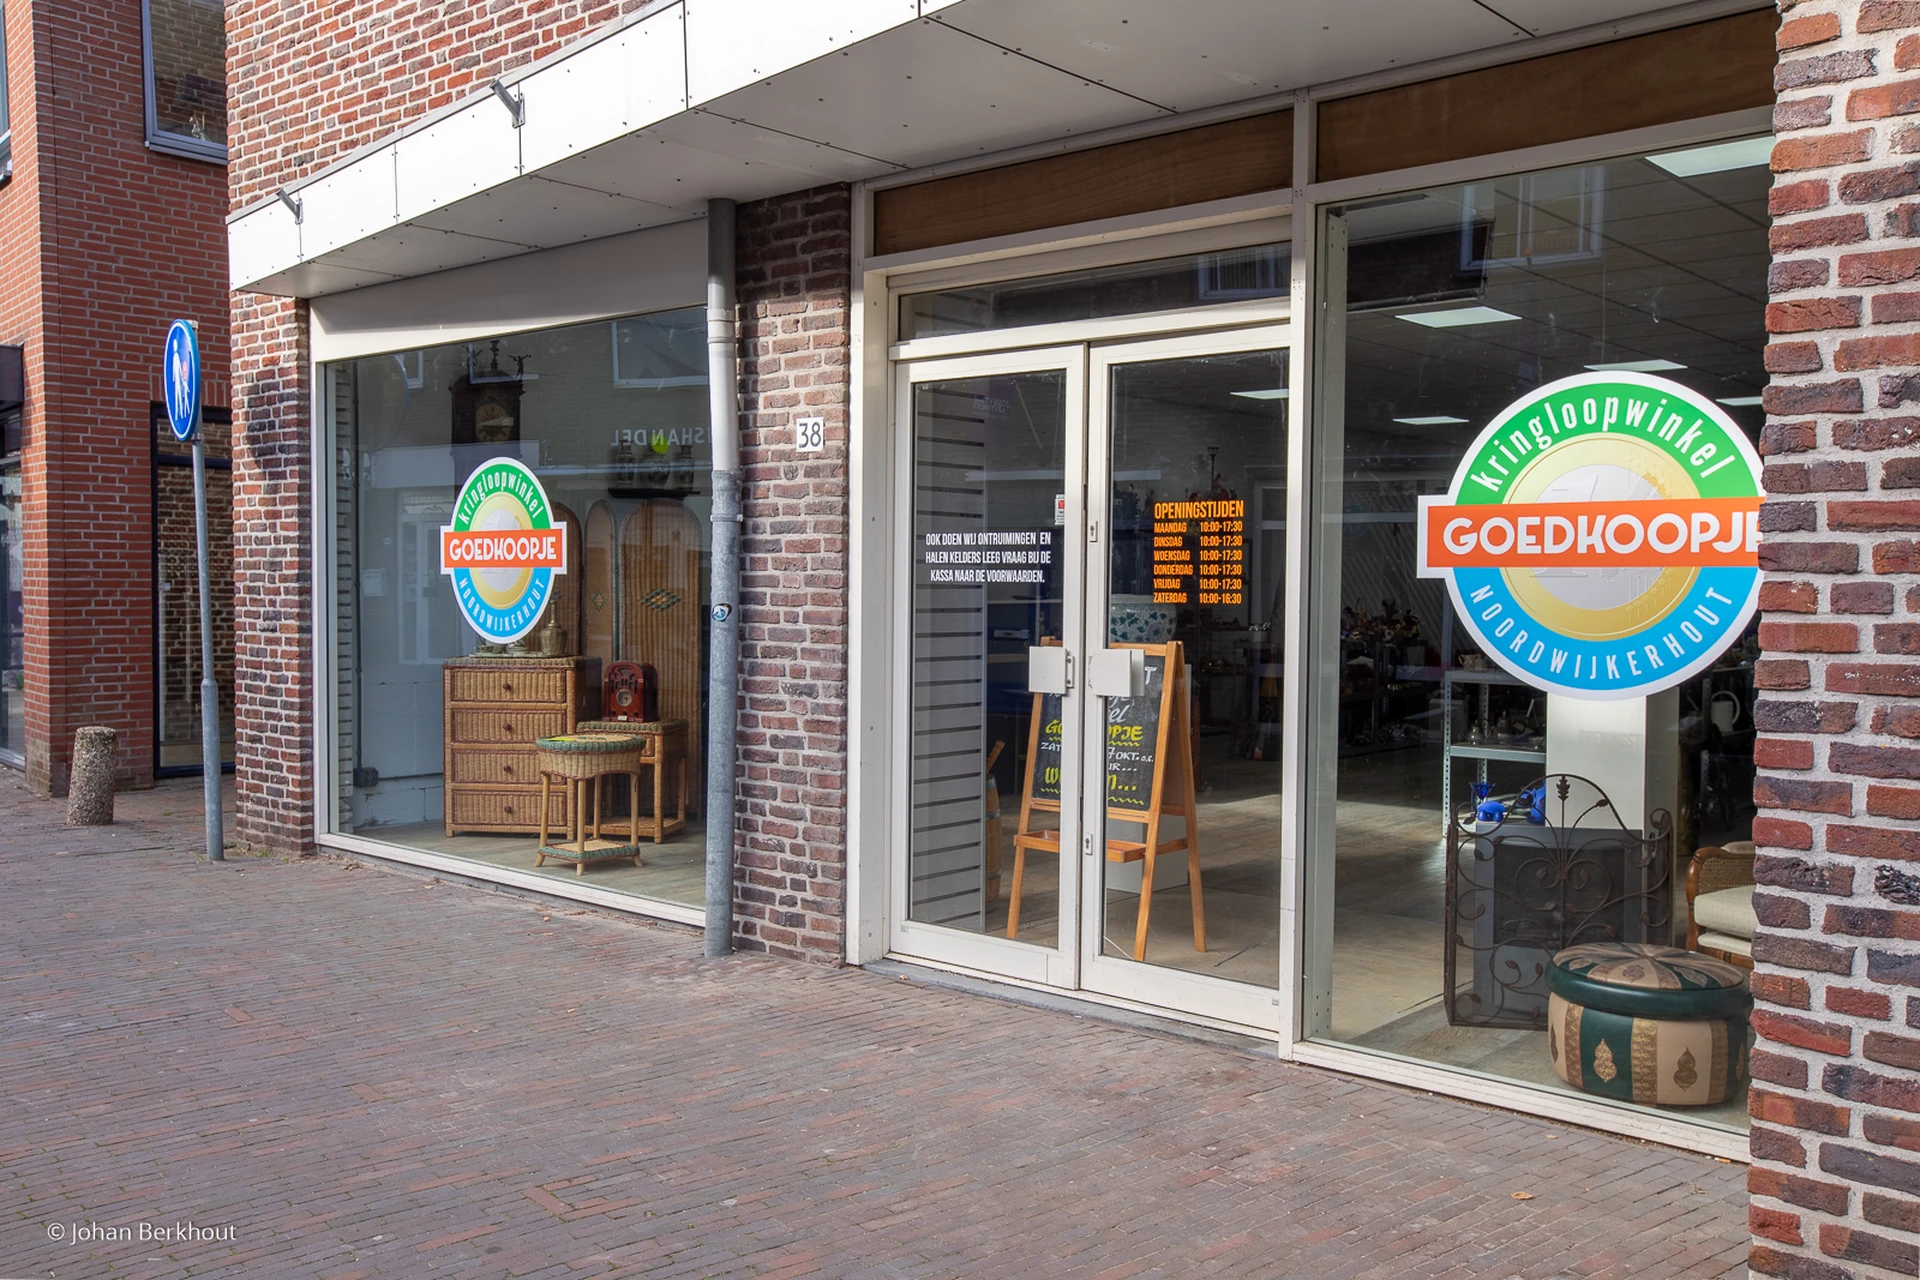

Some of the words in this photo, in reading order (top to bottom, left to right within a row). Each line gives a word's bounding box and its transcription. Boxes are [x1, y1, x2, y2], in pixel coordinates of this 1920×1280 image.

[799, 422, 822, 449] 38
[1470, 396, 1736, 493] kringloopwinkel
[458, 471, 544, 525] kringloopwinkel
[1154, 500, 1244, 519] OPENINGSTIJDEN
[1154, 522, 1187, 533] MAANDAG
[1200, 521, 1243, 532] 10:00-17:30
[925, 533, 942, 546] OOK
[942, 533, 962, 546] DOEN
[963, 533, 977, 545] WIJ
[977, 532, 1036, 545] ONTRUIMINGEN
[1040, 532, 1051, 545] EN
[1154, 536, 1183, 547] DINSDAG
[1200, 535, 1243, 547] 10:00-17:30
[449, 536, 557, 561] GOEDKOOPJE
[925, 551, 949, 564] HALEN
[949, 551, 981, 563] KELDERS
[982, 551, 1001, 563] LEEG
[1001, 551, 1027, 563] VRAAG
[1028, 551, 1039, 563] BIJ
[1040, 551, 1051, 563] DE
[1154, 550, 1191, 561] WOENSDAG
[1200, 550, 1243, 561] 10:00-17:30
[930, 569, 954, 581] KASSA
[954, 570, 975, 581] NAAR
[975, 570, 985, 581] DE
[986, 569, 1045, 582] VOORWAARDEN.
[1154, 564, 1193, 575] DONDERDAG
[1200, 564, 1242, 575] 10:00-17:30
[1153, 578, 1181, 589] VRIJDAG
[1199, 578, 1242, 590] 10:00-17:30
[1153, 592, 1187, 603] ZATERDAG
[458, 577, 545, 632] NOORDWIJKERHOUT
[1470, 584, 1732, 680] NOORDWIJKERHOUT
